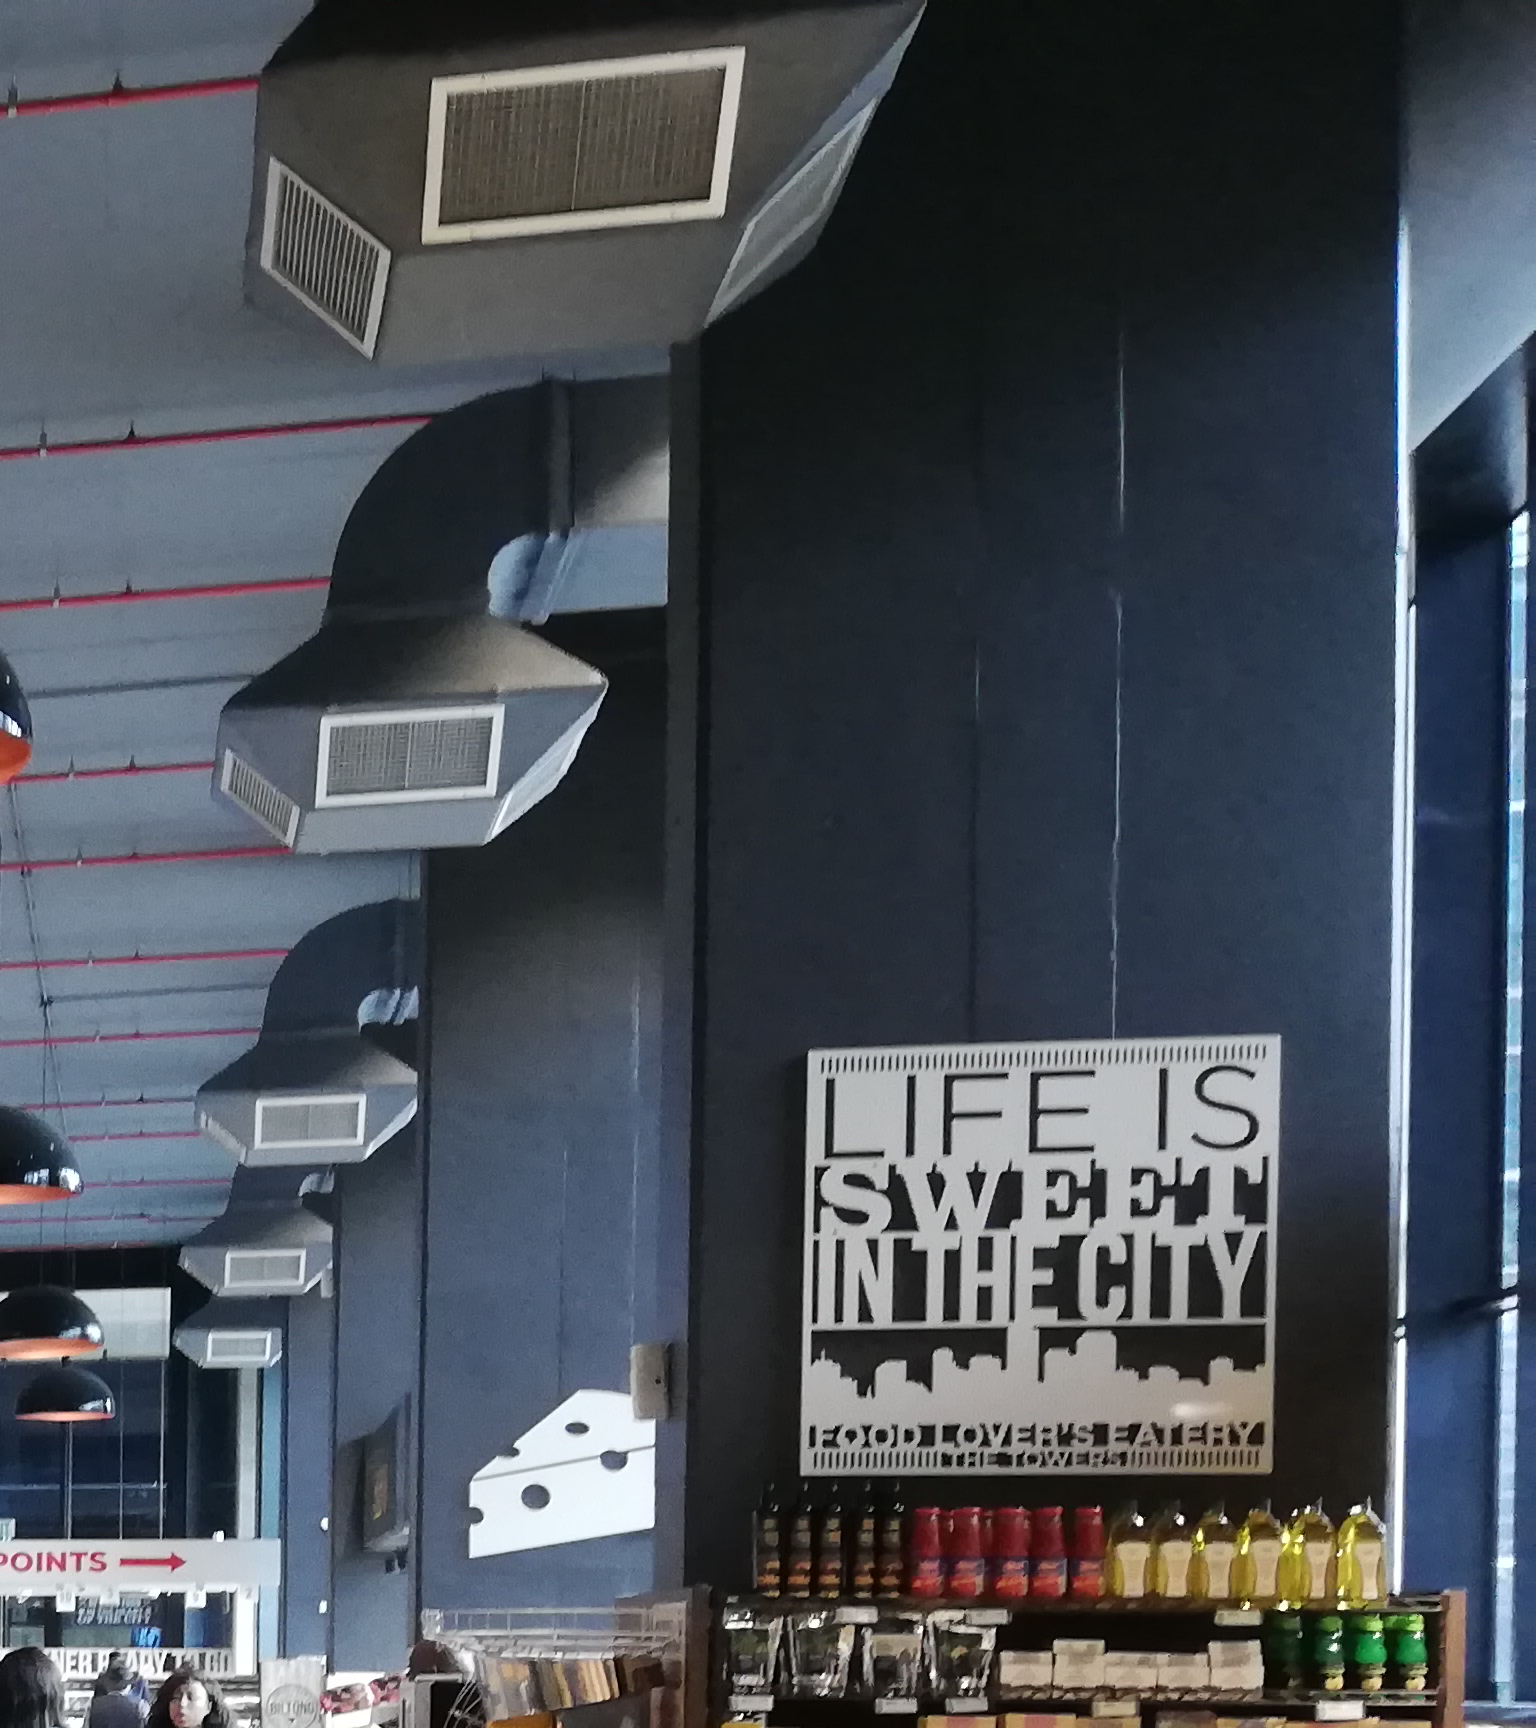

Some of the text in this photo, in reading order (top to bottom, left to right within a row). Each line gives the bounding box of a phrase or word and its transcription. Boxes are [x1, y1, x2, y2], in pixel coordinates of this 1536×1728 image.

[824, 1064, 1261, 1159] LIFE IS
[817, 1157, 1267, 1234] SWEET
[817, 1228, 1266, 1325] IN THE CITY
[813, 1423, 923, 1449] FOOD
[1108, 1420, 1265, 1448] EATERY
